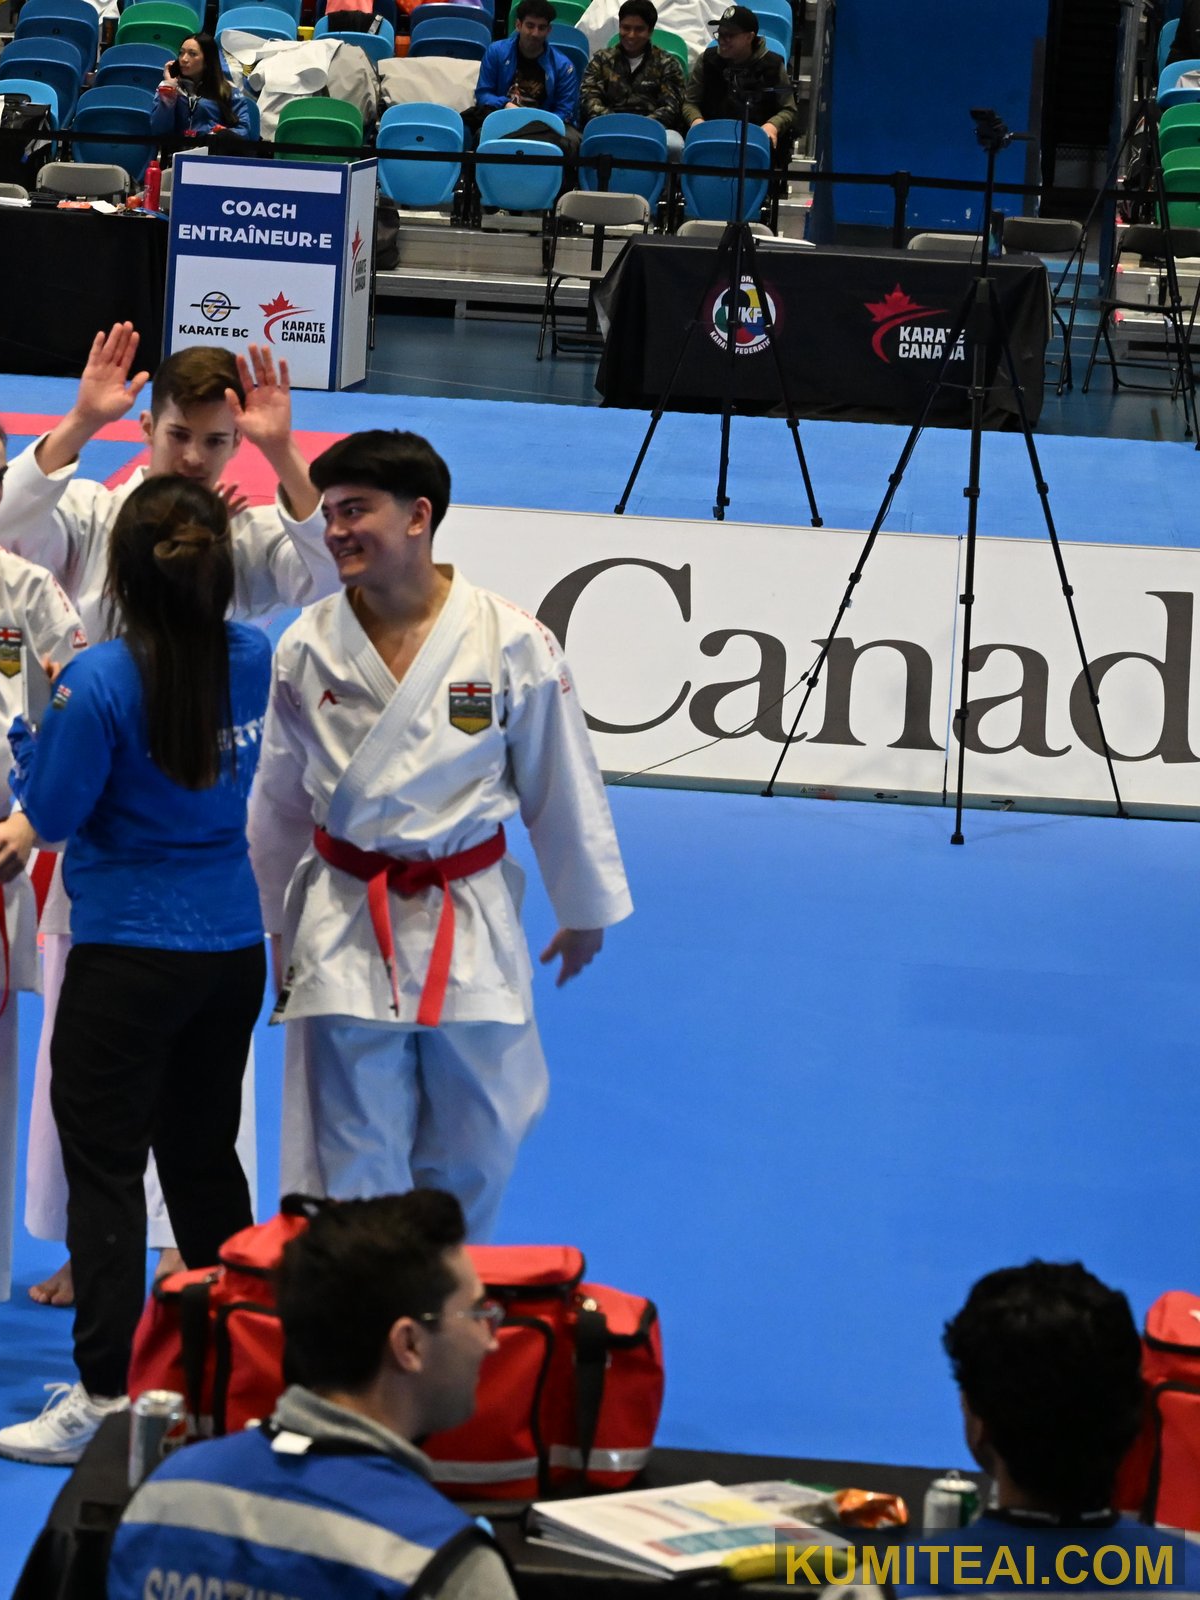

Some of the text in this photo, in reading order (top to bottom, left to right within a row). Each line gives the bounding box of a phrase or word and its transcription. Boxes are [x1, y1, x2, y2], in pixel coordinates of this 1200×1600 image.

[221, 200, 297, 219] COACH
[178, 224, 332, 248] ENTRAÎNEUR·E
[178, 324, 249, 338] KARATE BC
[282, 320, 326, 333] KARATE
[281, 331, 326, 344] CANADA
[535, 557, 1200, 764] Canad
